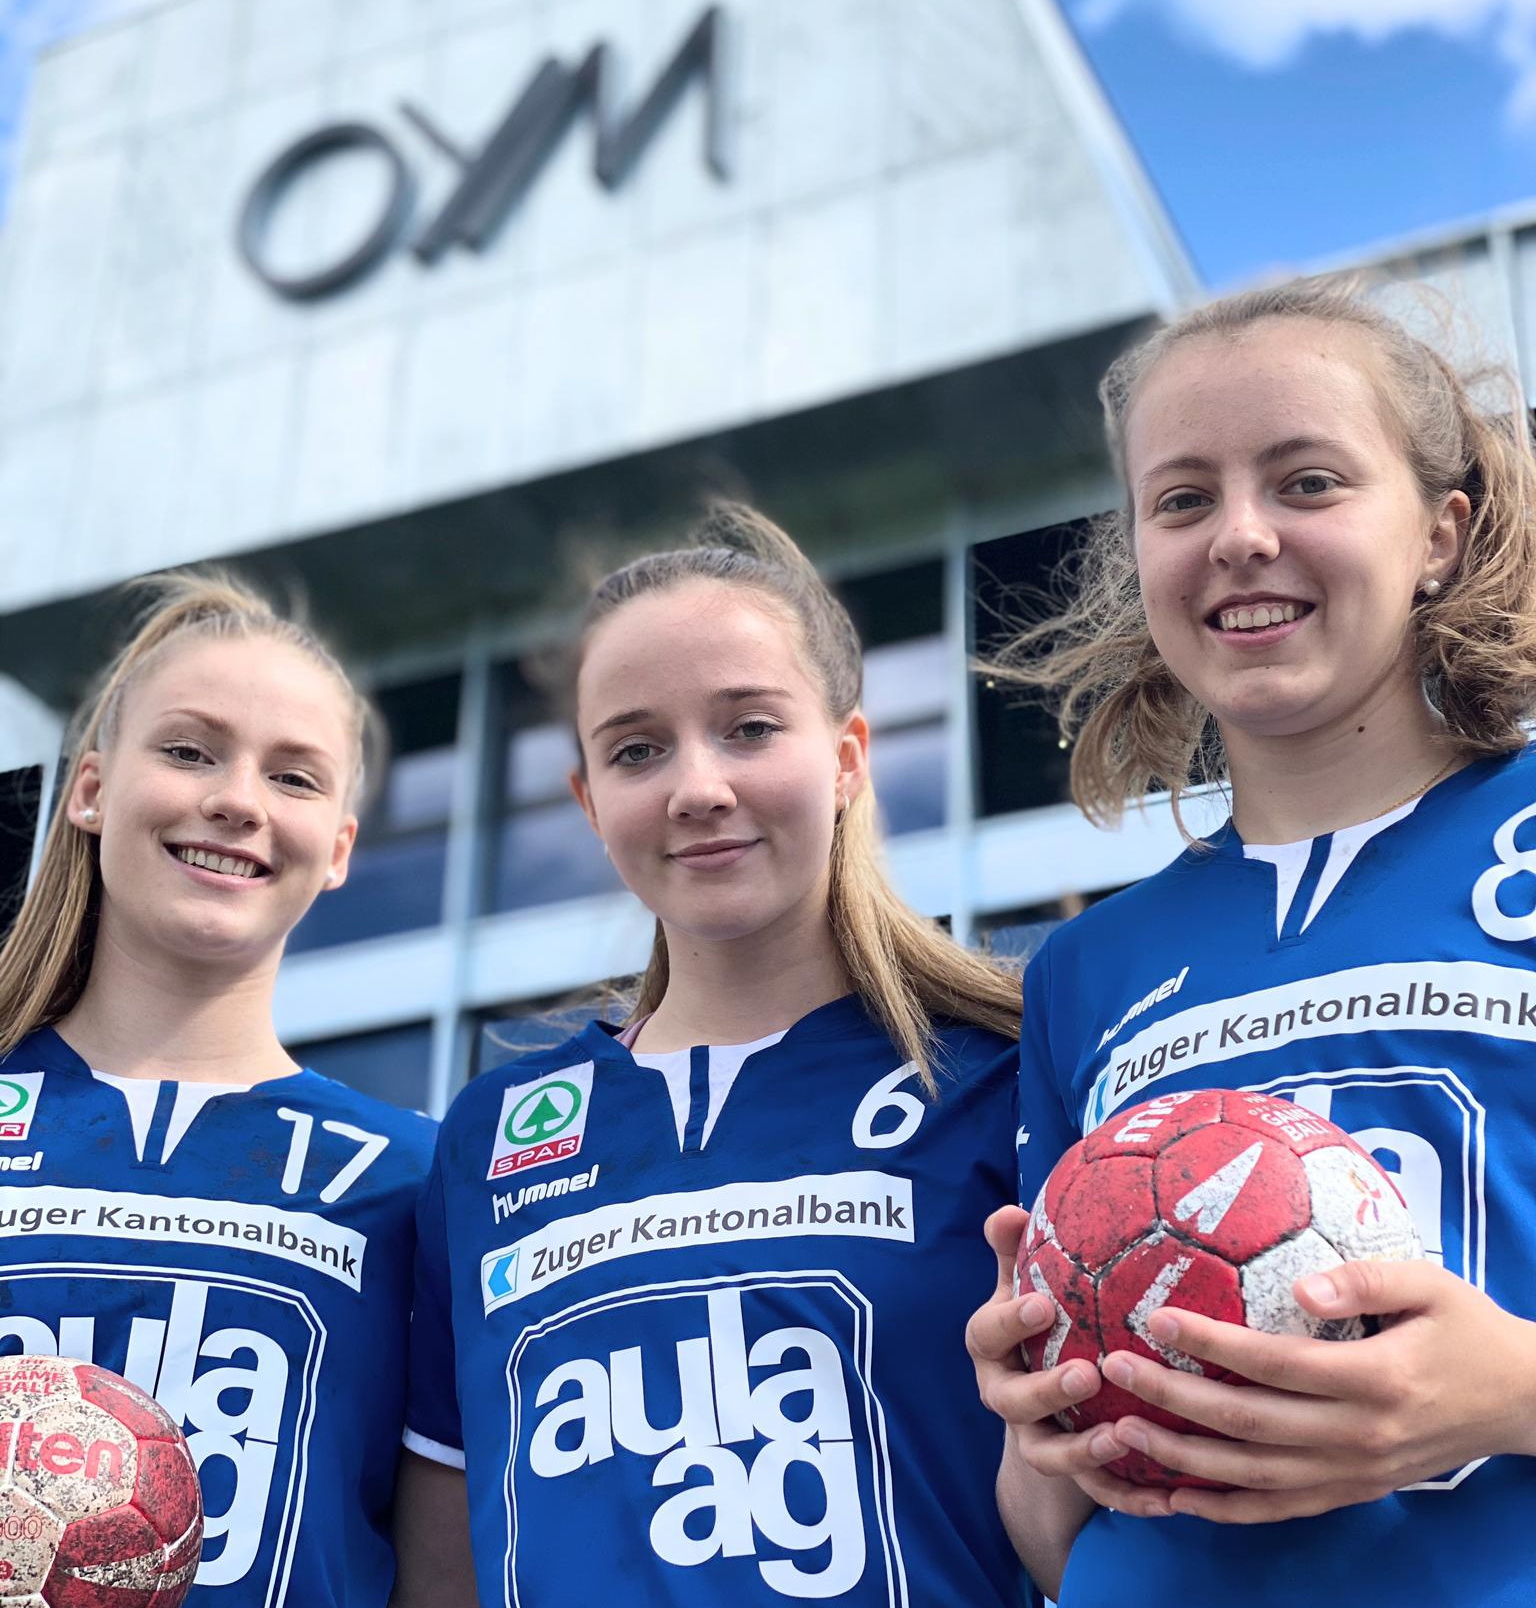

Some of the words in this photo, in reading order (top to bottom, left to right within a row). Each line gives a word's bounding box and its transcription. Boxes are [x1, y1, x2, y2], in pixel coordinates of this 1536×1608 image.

[1114, 1029, 1209, 1097] Zuger
[1219, 982, 1536, 1048] Kantonalbank
[852, 1058, 926, 1149] 6
[277, 1107, 390, 1203] 17
[492, 1164, 600, 1225] hummel
[496, 1139, 577, 1173] SPAR
[0, 1207, 86, 1233] uger
[97, 1206, 357, 1280] Kantonalbank
[531, 1226, 622, 1281] Zuger
[630, 1194, 907, 1245] Kantonalbank
[529, 1290, 853, 1478] aula
[0, 1421, 123, 1480] lten
[650, 1440, 866, 1598] ag
